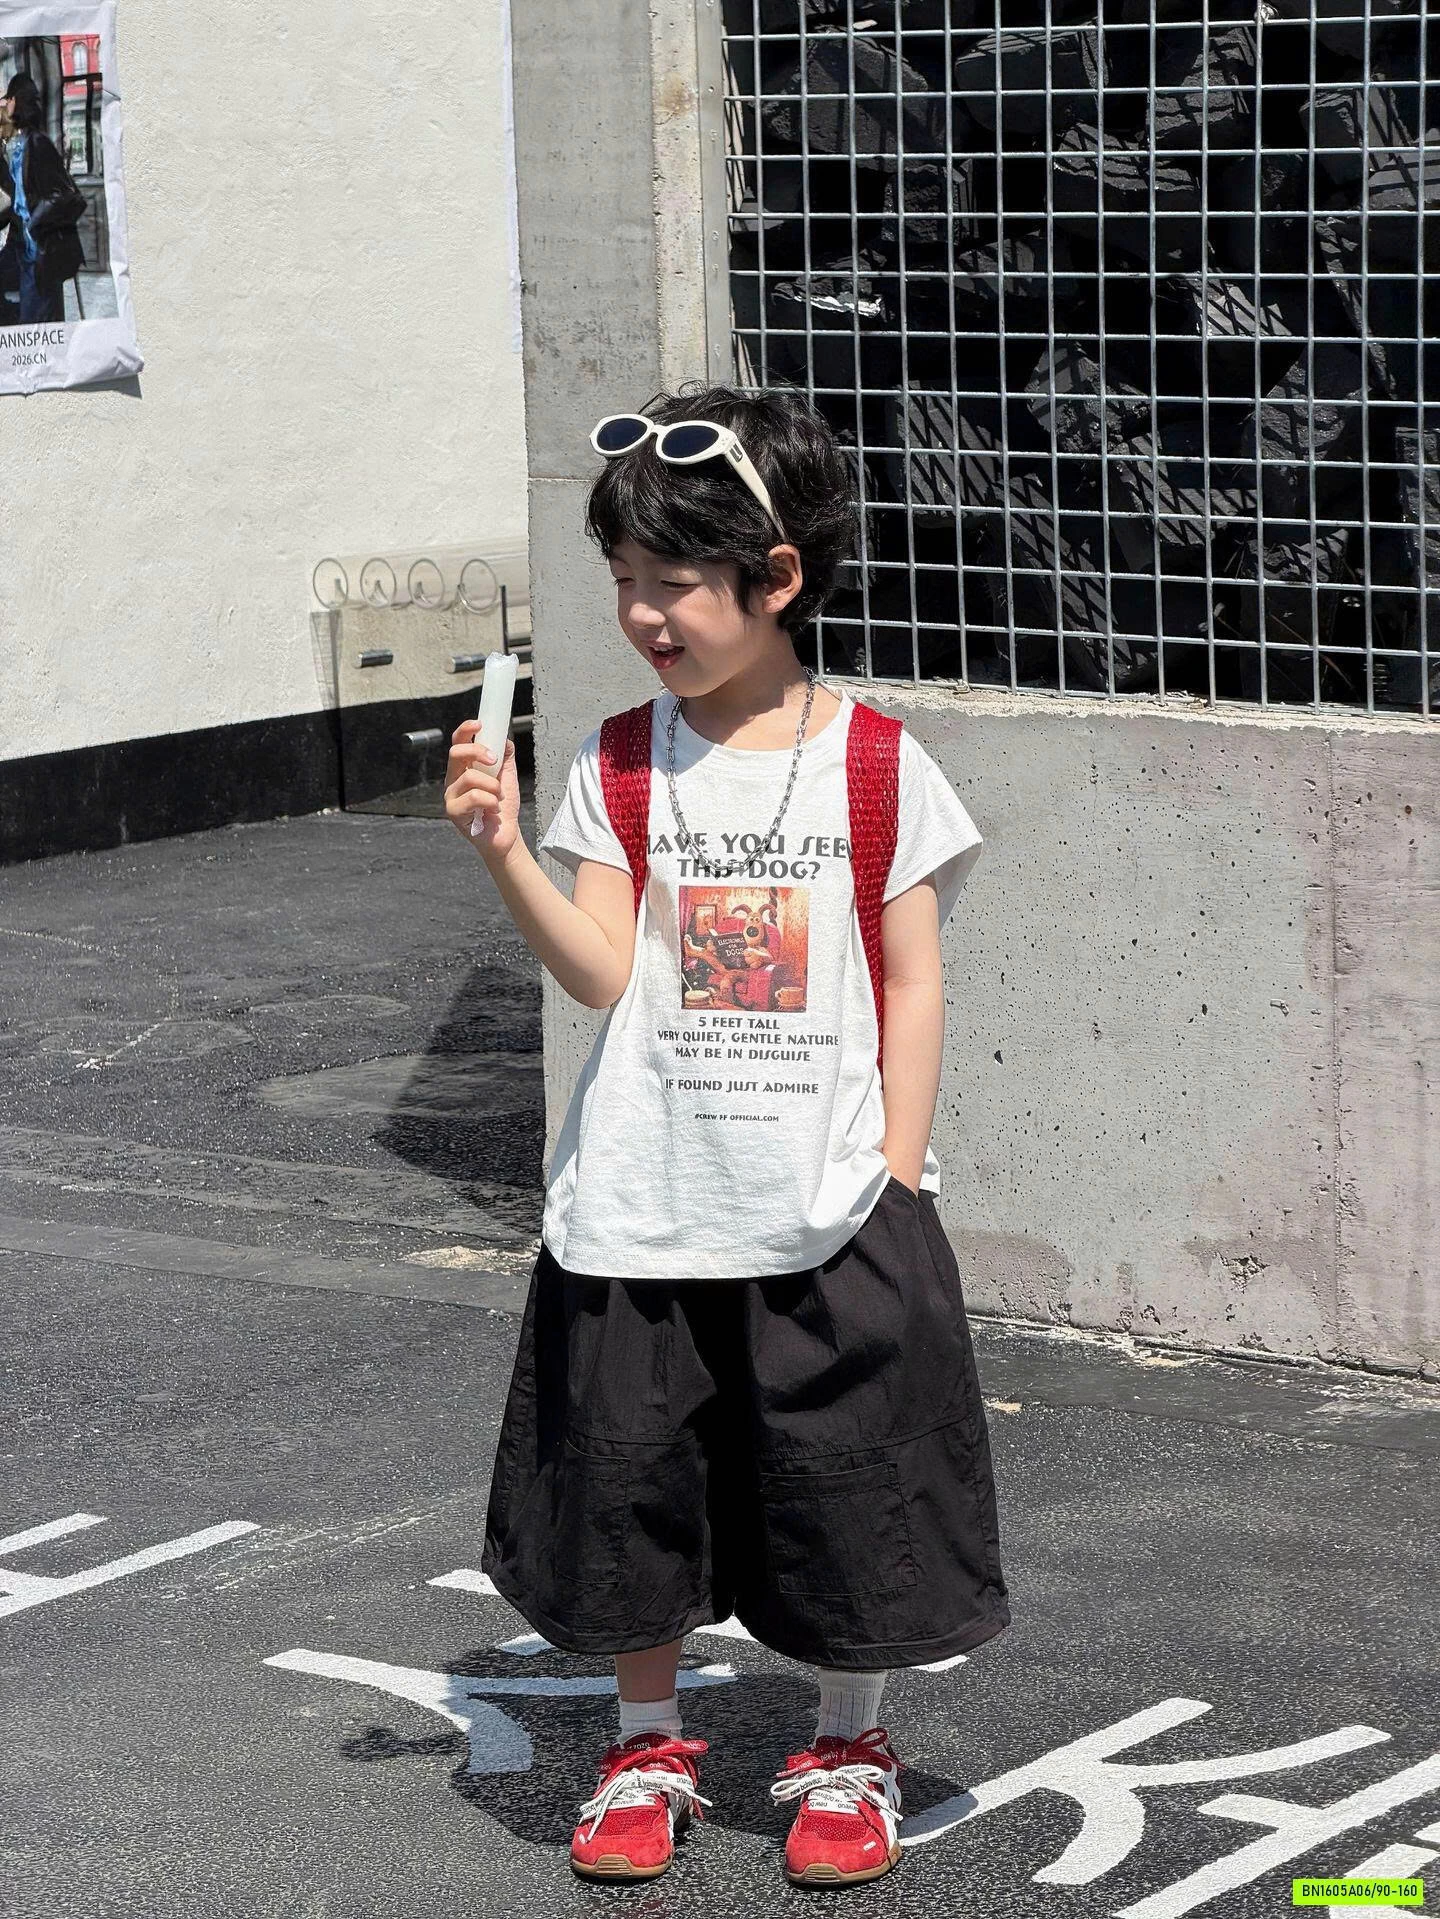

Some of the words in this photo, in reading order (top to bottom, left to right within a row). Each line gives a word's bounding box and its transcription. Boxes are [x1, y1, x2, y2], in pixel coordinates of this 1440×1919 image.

[12, 353, 47, 366] 2026.CN
[648, 833, 708, 855] AVE
[720, 832, 785, 855] YOU
[797, 836, 853, 861] SEE
[749, 859, 821, 880] DOG?
[698, 1016, 707, 1027] 5
[712, 1017, 743, 1029] FEET
[747, 1018, 780, 1030] TALL
[658, 1030, 680, 1041] VERY
[683, 1031, 726, 1044] QUIET,
[731, 1032, 782, 1045] GENTLE
[787, 1034, 839, 1046] NATURE
[675, 1047, 700, 1058] MAY
[704, 1048, 722, 1059] BE
[727, 1049, 743, 1059] IN
[749, 1049, 811, 1062] DISGUISE
[665, 1079, 674, 1090] IF
[678, 1079, 723, 1091] FOUND
[726, 1081, 758, 1093] JUST
[762, 1082, 819, 1094] ADMIRE
